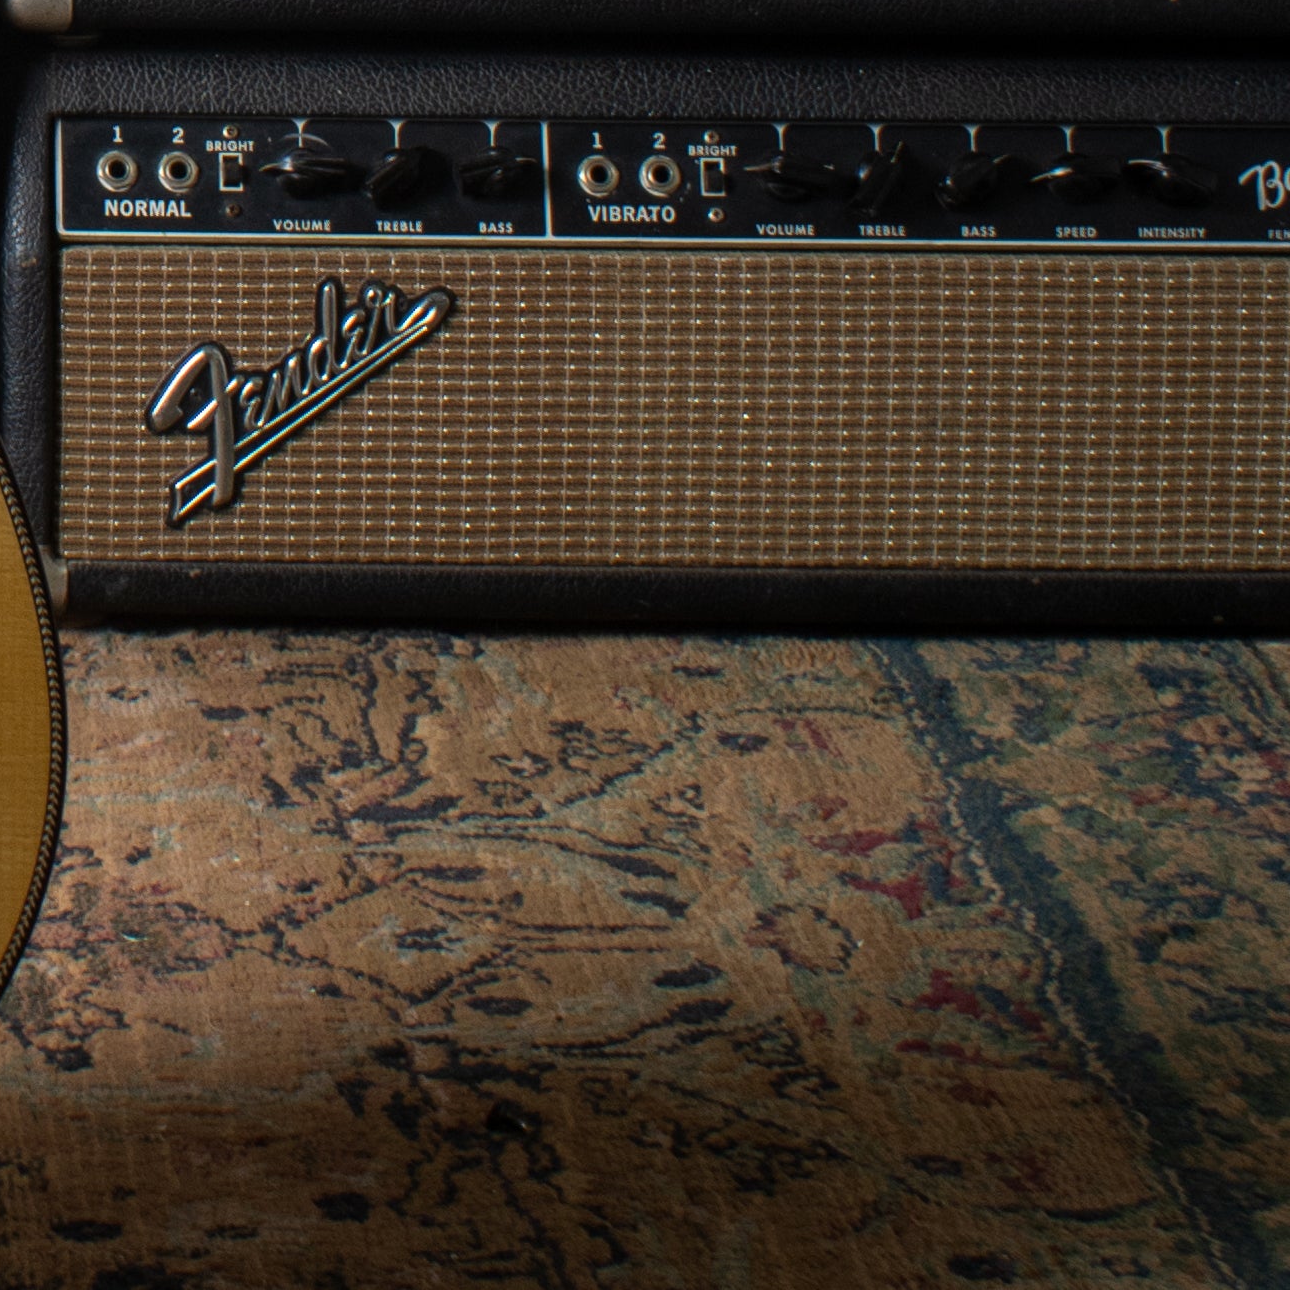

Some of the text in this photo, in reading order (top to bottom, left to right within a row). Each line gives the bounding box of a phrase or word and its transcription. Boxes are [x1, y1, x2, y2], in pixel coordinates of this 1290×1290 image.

[205, 139, 254, 152] BRIGHT
[688, 145, 737, 158] BRIGHT
[104, 199, 193, 218] NORMAL
[587, 205, 677, 223] VIBRATO
[273, 219, 514, 235] VOLUME TREBLE BASS
[756, 223, 1206, 239] VOLUME TREBLE BASS SPEED INTENSITY
[144, 276, 458, 528] Fender
